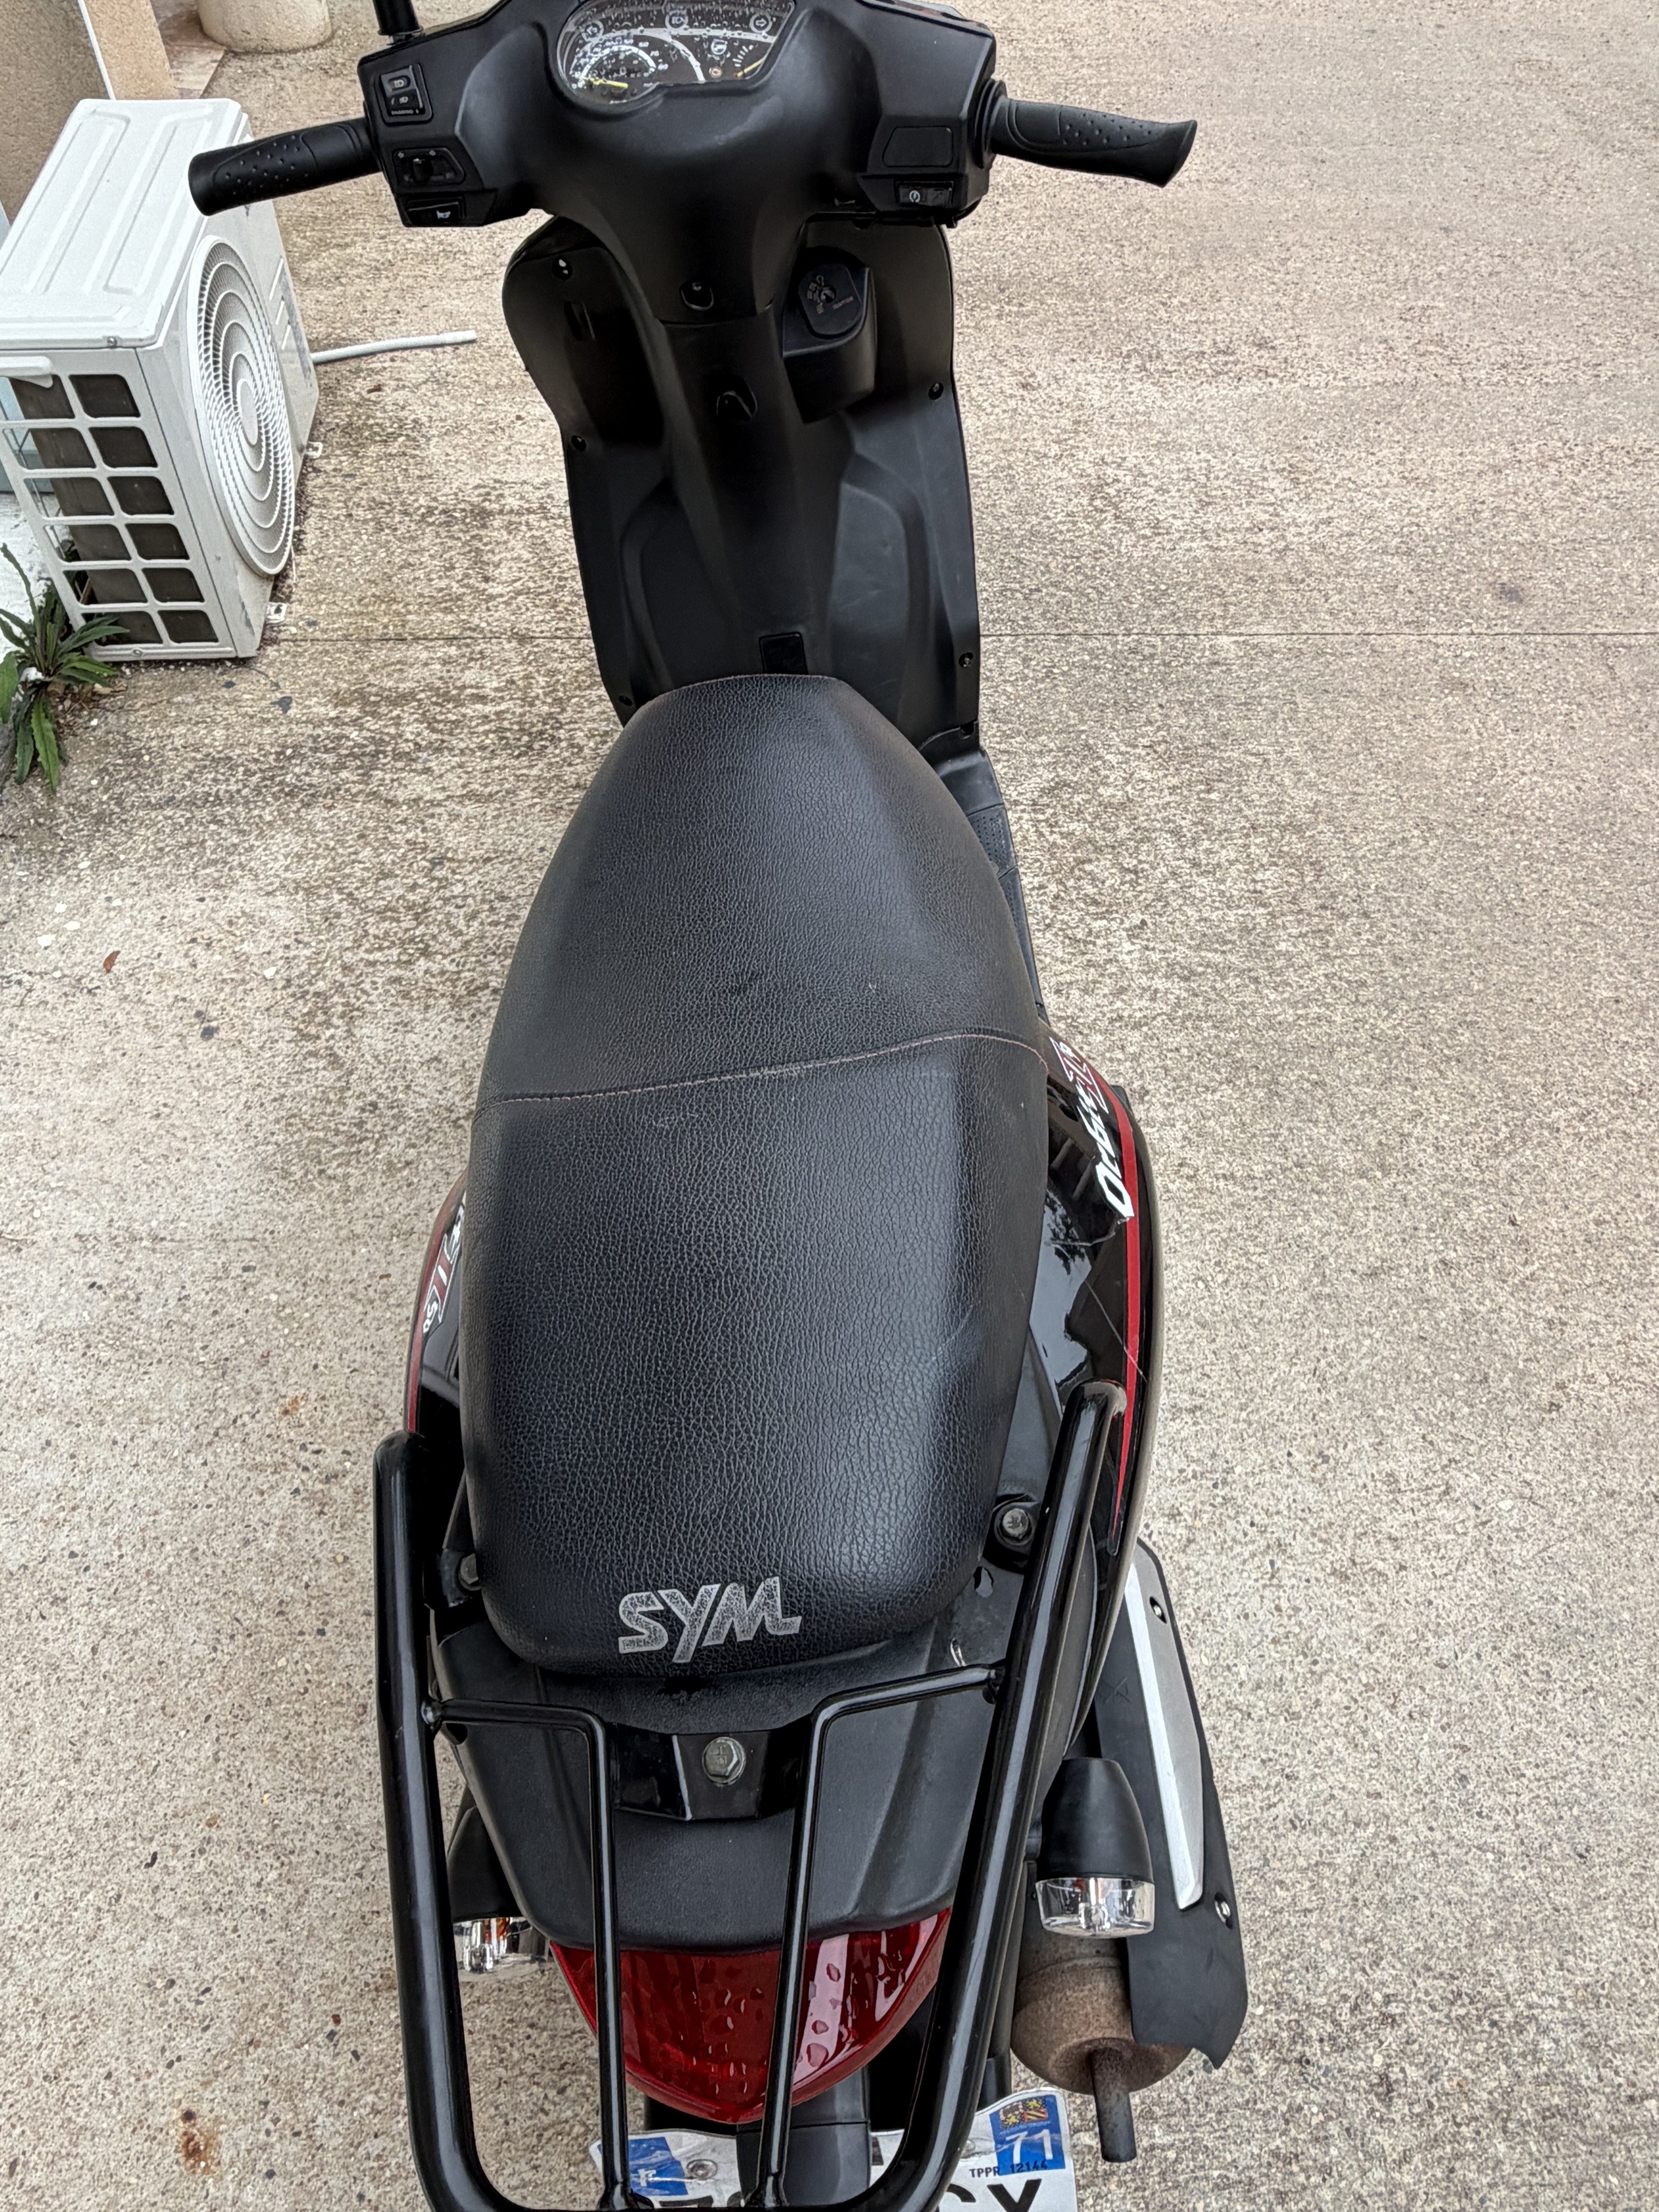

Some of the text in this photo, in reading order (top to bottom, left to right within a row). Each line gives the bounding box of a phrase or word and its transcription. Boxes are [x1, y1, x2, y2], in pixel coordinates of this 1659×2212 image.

[618, 1576, 802, 1663] SYM
[1006, 2129, 1053, 2165] 71
[969, 2166, 1000, 2178] TPPR
